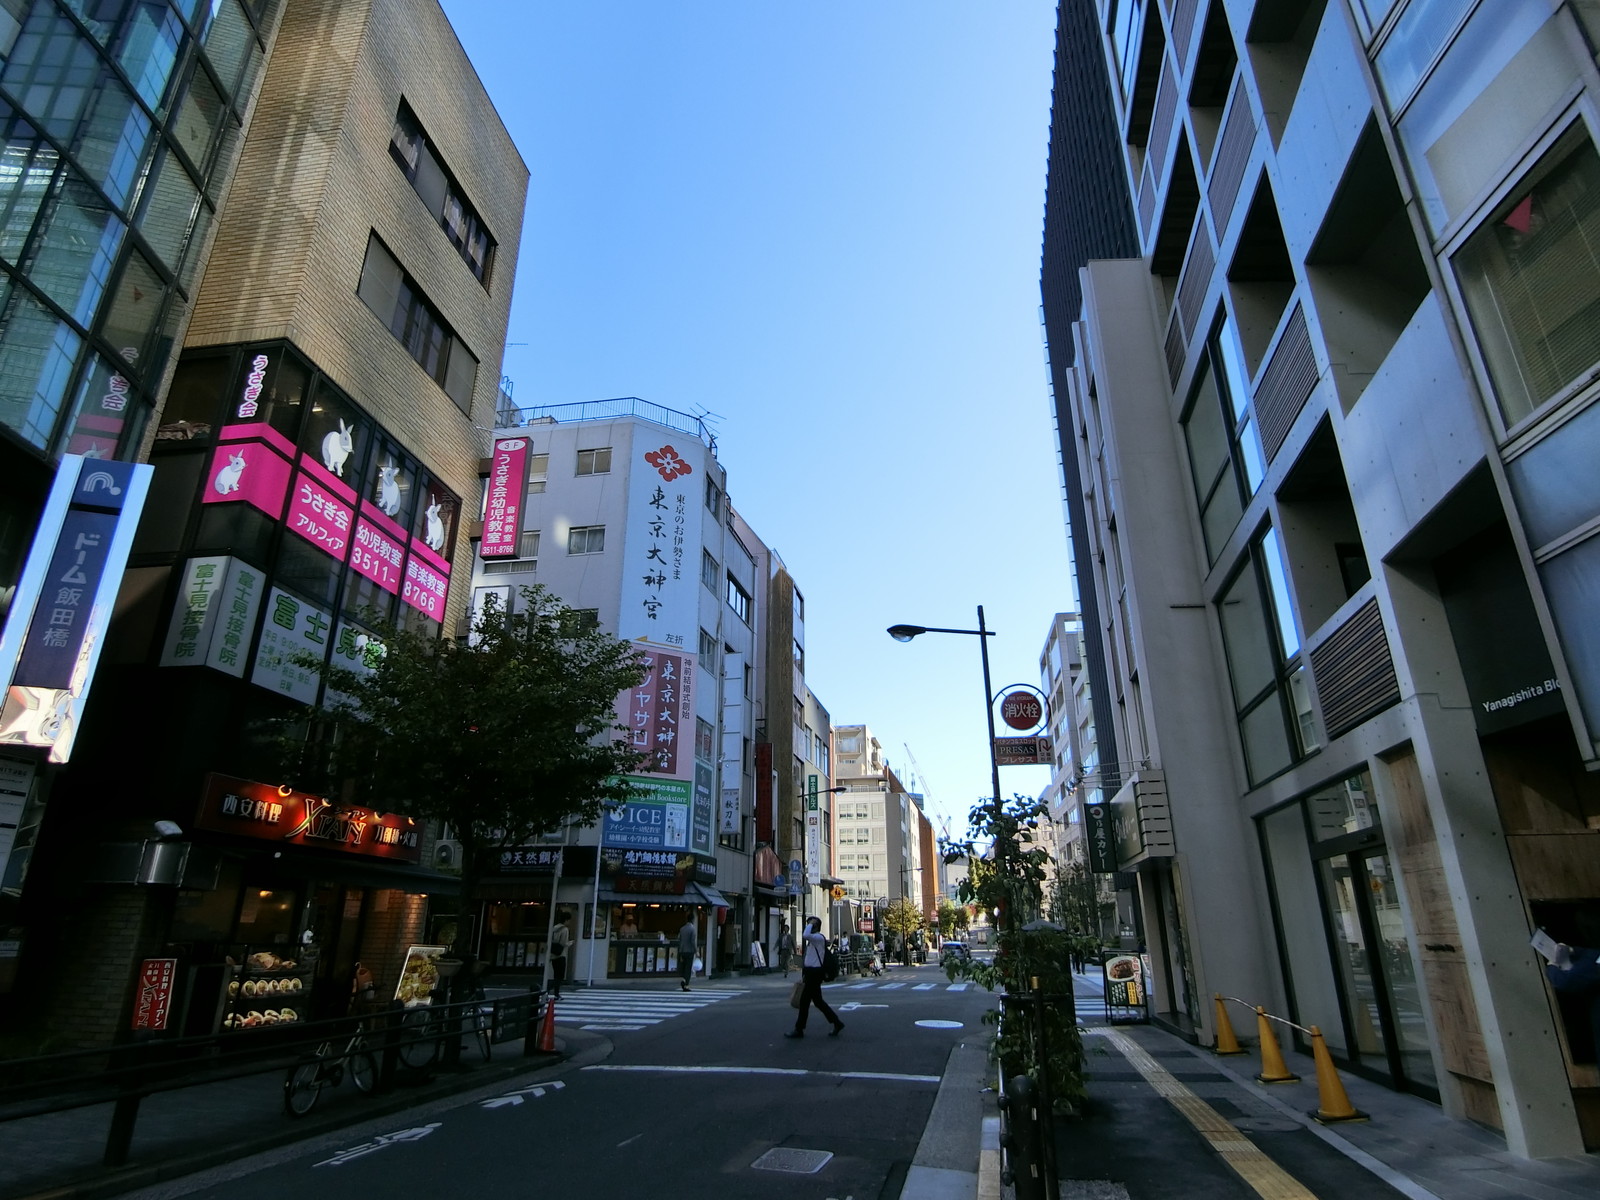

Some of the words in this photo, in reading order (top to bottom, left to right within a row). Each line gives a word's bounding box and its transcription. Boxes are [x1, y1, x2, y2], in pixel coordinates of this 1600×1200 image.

[238, 354, 269, 418] うさぎ会
[486, 454, 511, 544] うさぎ会幼児教室
[502, 505, 517, 544] 音楽教室
[296, 511, 344, 551] アルフィア
[352, 546, 396, 583] 3511-
[403, 580, 437, 612] 8766
[301, 484, 350, 531] うさぎ会
[356, 524, 404, 568] 幼児教室
[407, 560, 447, 598] 音楽教室
[481, 544, 515, 555] 3511-8766
[642, 485, 669, 621] 東京大神宮
[672, 493, 685, 581] 東京のお伊勢さま
[42, 530, 102, 648] ドーム飯田橋
[174, 563, 217, 658] 富士見接骨院
[218, 570, 256, 667] 富士見接骨院
[665, 632, 684, 645] 左折
[633, 656, 654, 754] マンヤサロ
[656, 660, 677, 768] 東京大神宮
[681, 658, 692, 720] 神前結婚式創始
[1004, 702, 1039, 718] 消火栓
[1482, 686, 1544, 713] Yanagishita
[999, 745, 1036, 755] PRESAS
[221, 792, 284, 824] 西安料理
[628, 807, 662, 826] ICE
[656, 793, 688, 804] Bookstore
